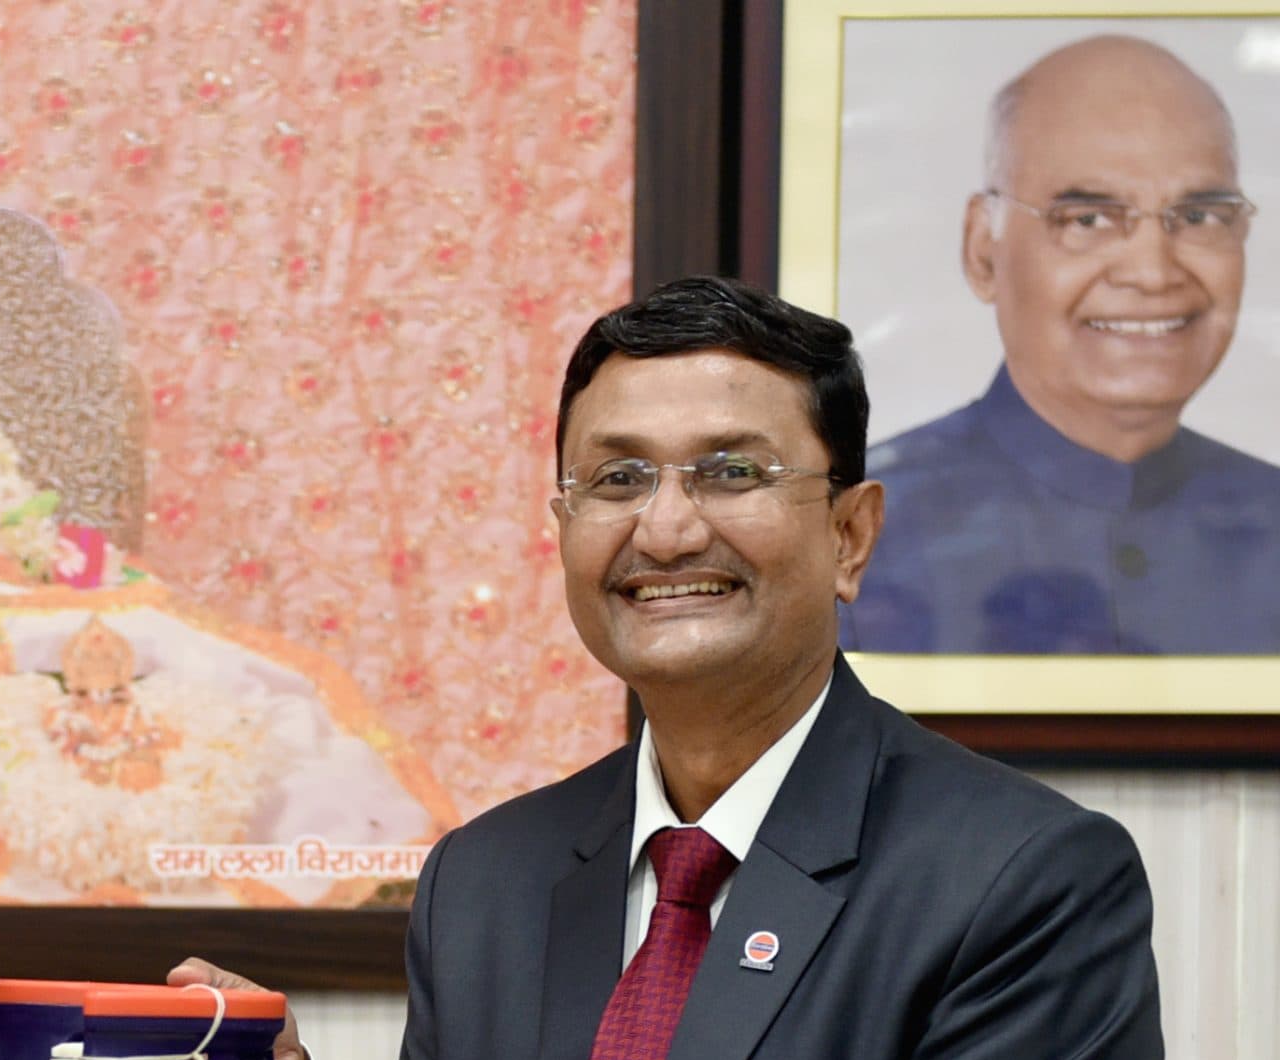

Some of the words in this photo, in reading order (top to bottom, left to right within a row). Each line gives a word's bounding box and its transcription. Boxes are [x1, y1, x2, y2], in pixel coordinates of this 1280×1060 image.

[153, 846, 207, 872] राम
[218, 846, 287, 873] लला
[295, 838, 427, 873] विराजमा
